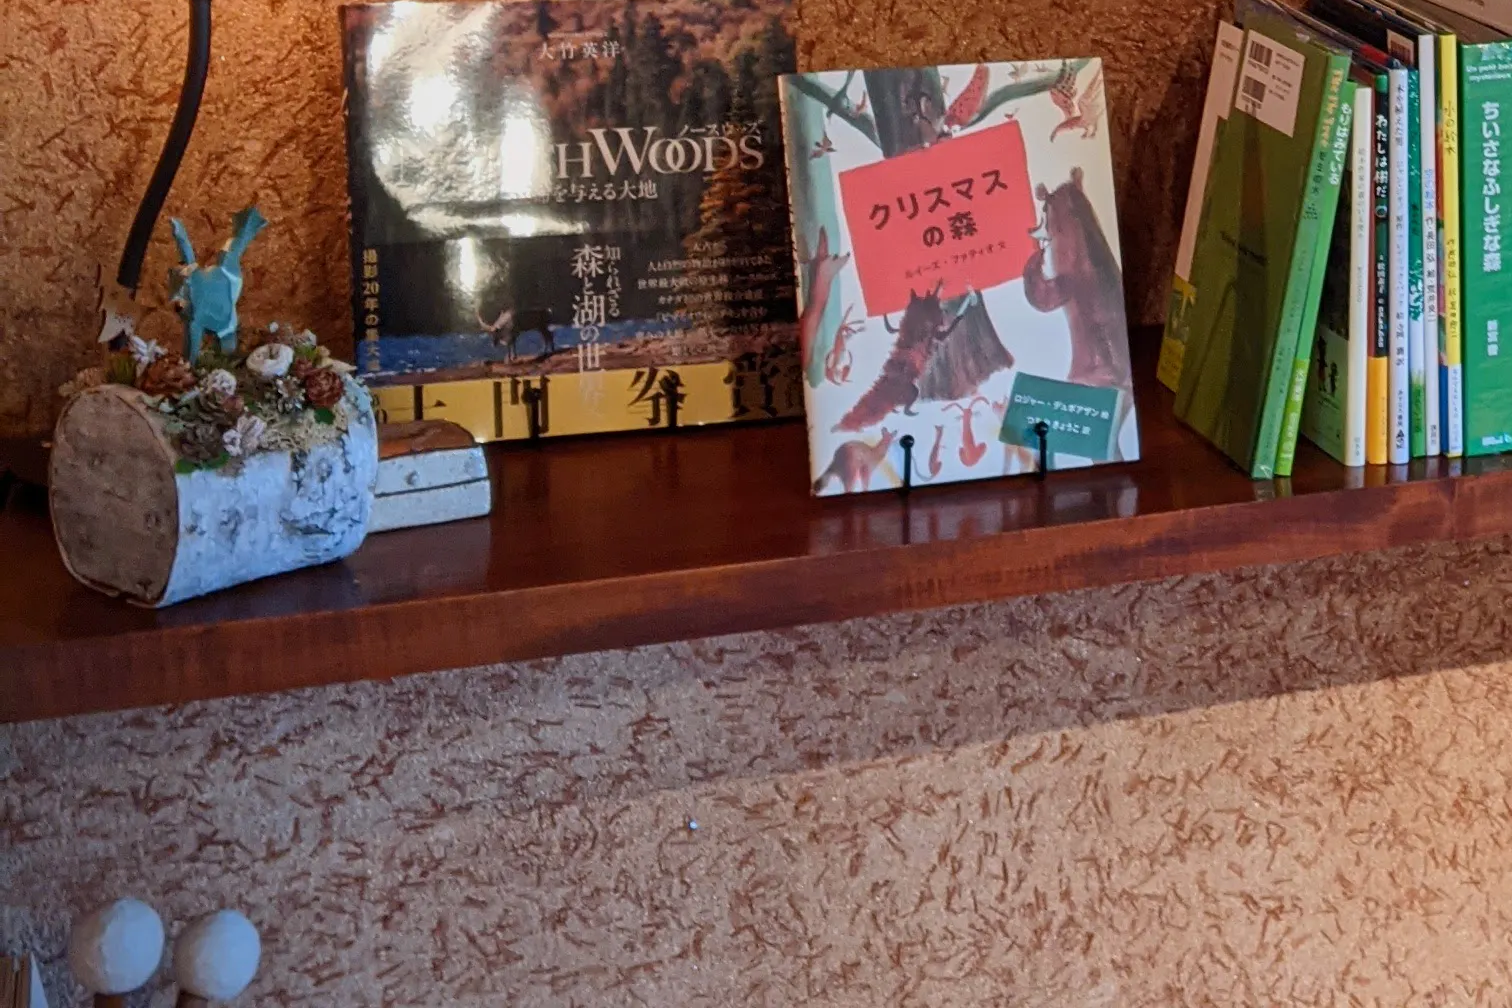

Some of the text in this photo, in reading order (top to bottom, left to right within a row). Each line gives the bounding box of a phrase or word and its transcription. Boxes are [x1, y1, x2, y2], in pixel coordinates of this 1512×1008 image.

[539, 40, 622, 61] 大竹英洋
[867, 168, 1009, 231] クリスマス
[1481, 101, 1502, 273] ちいさなふしぎな森
[922, 211, 979, 249] の森
